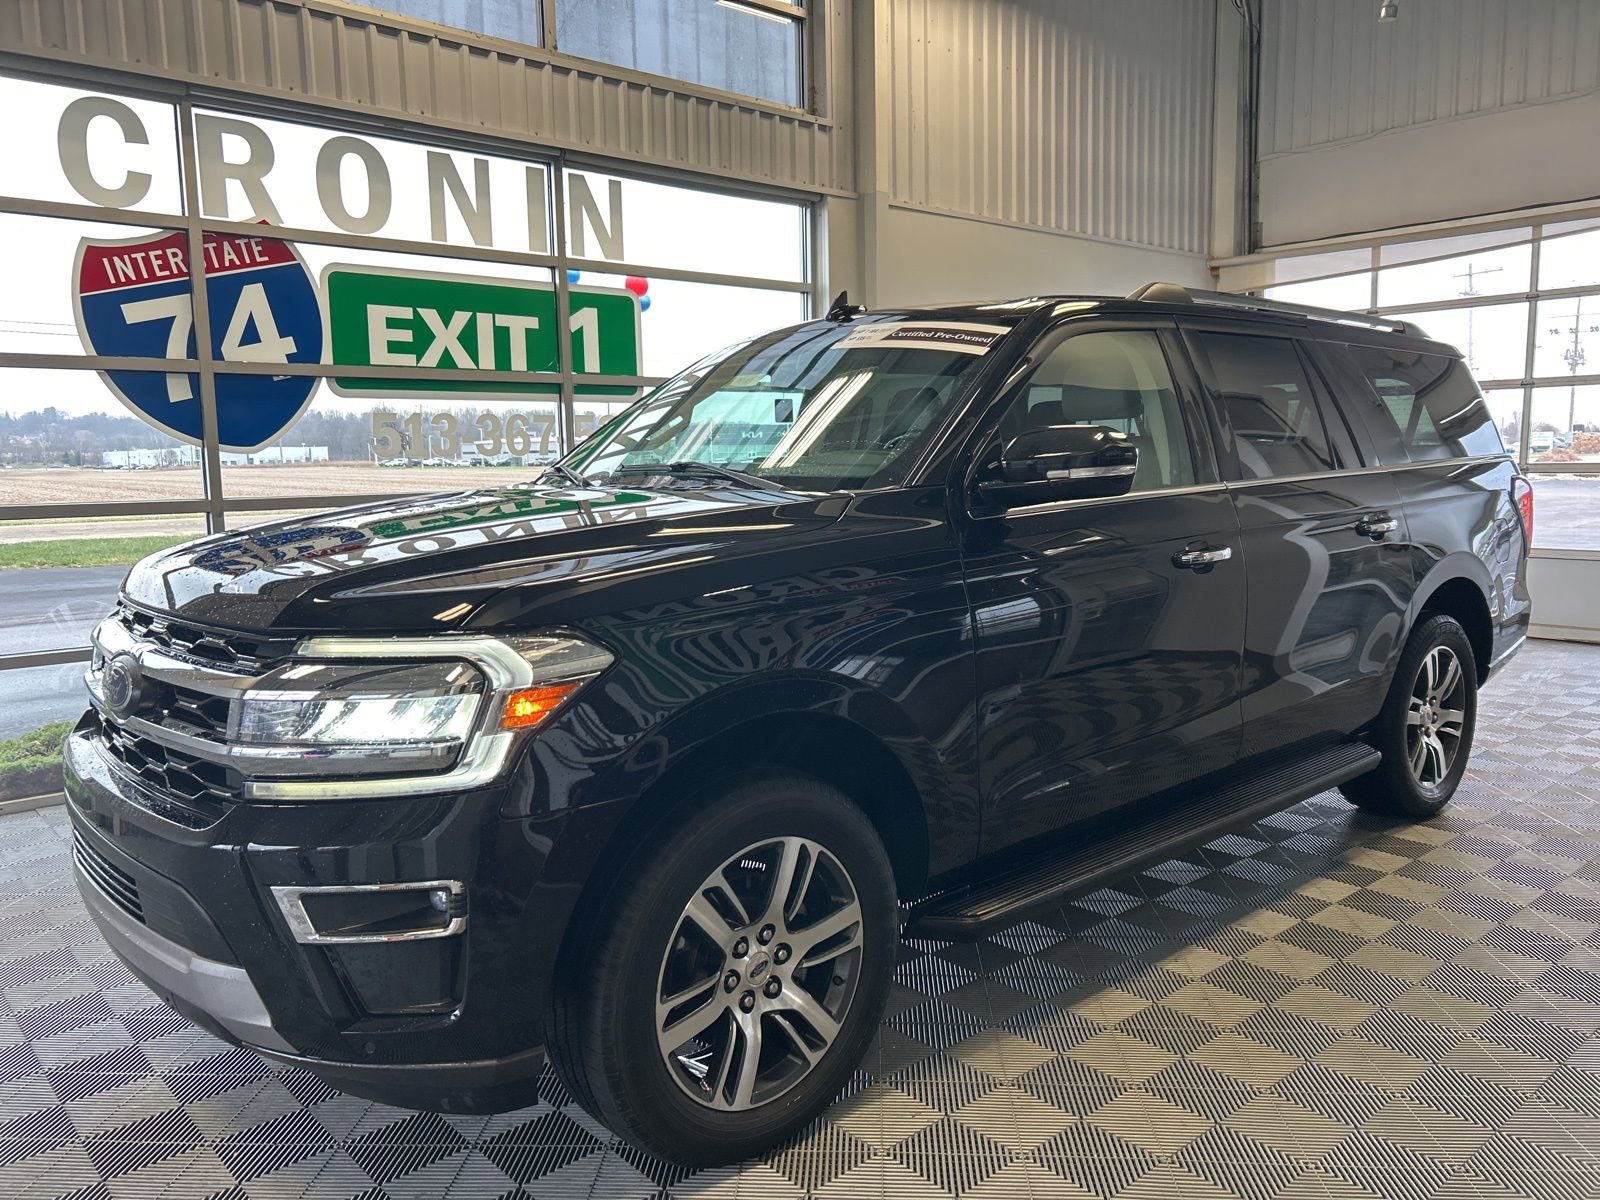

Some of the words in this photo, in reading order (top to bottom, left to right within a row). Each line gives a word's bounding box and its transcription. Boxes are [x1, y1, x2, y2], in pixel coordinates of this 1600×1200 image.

[58, 96, 625, 262] CRONIN
[102, 237, 269, 284] INTERTATE
[120, 282, 298, 403] 74
[366, 303, 539, 372] EXIT
[569, 307, 601, 374] 1
[891, 331, 935, 339] Certified
[934, 332, 993, 343] Pre-Owned
